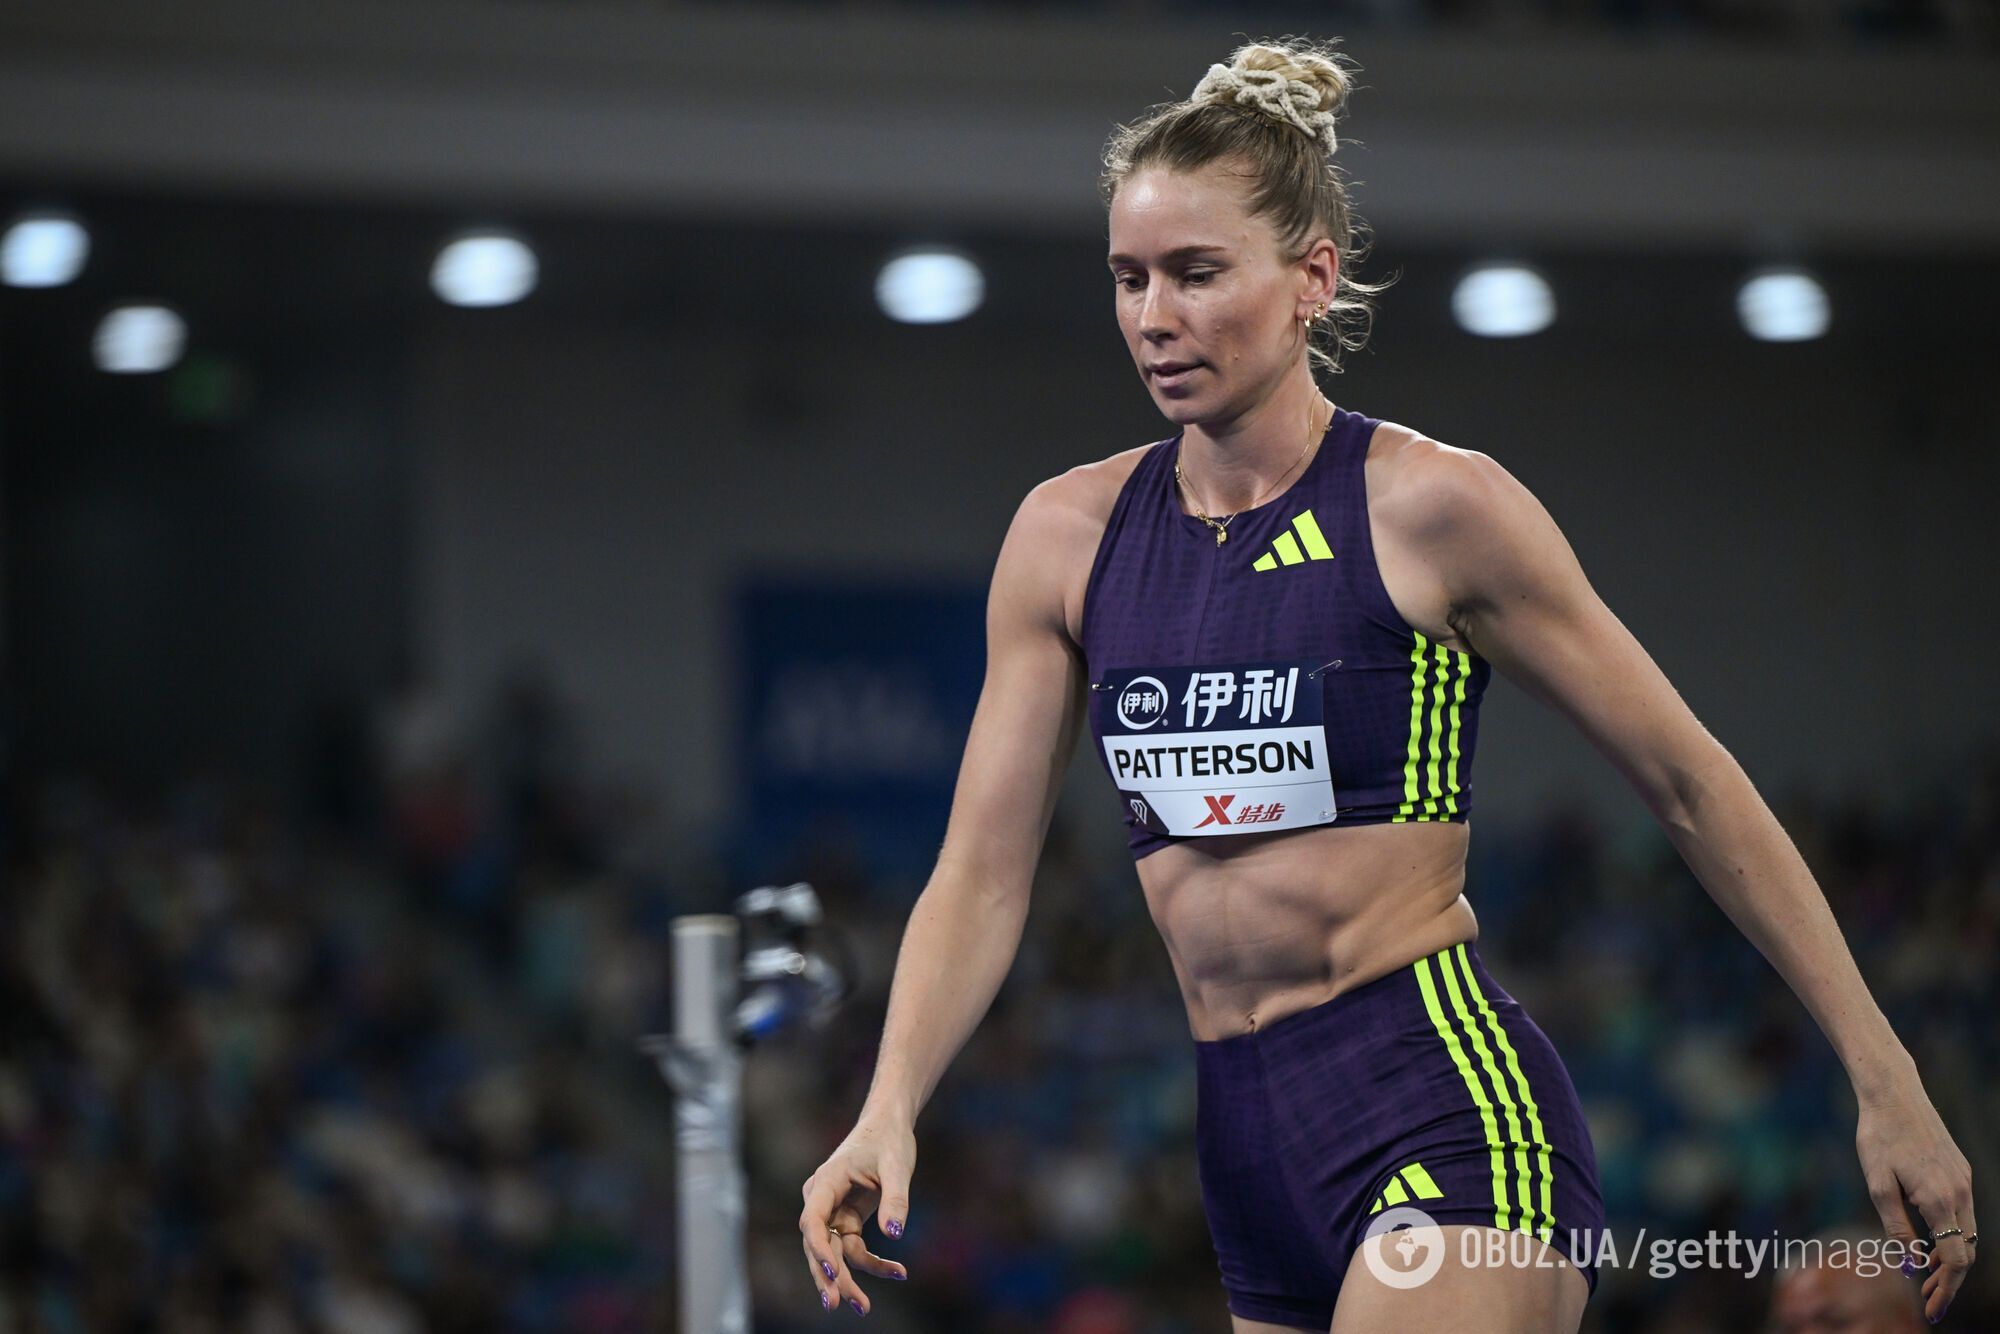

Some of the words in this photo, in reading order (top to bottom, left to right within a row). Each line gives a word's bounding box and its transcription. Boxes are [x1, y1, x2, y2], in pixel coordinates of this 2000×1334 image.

[1123, 691, 1160, 715] 伊利
[1181, 667, 1299, 728] 伊利
[1113, 740, 1315, 779] PATTERSON
[1234, 802, 1286, 825] 特步
